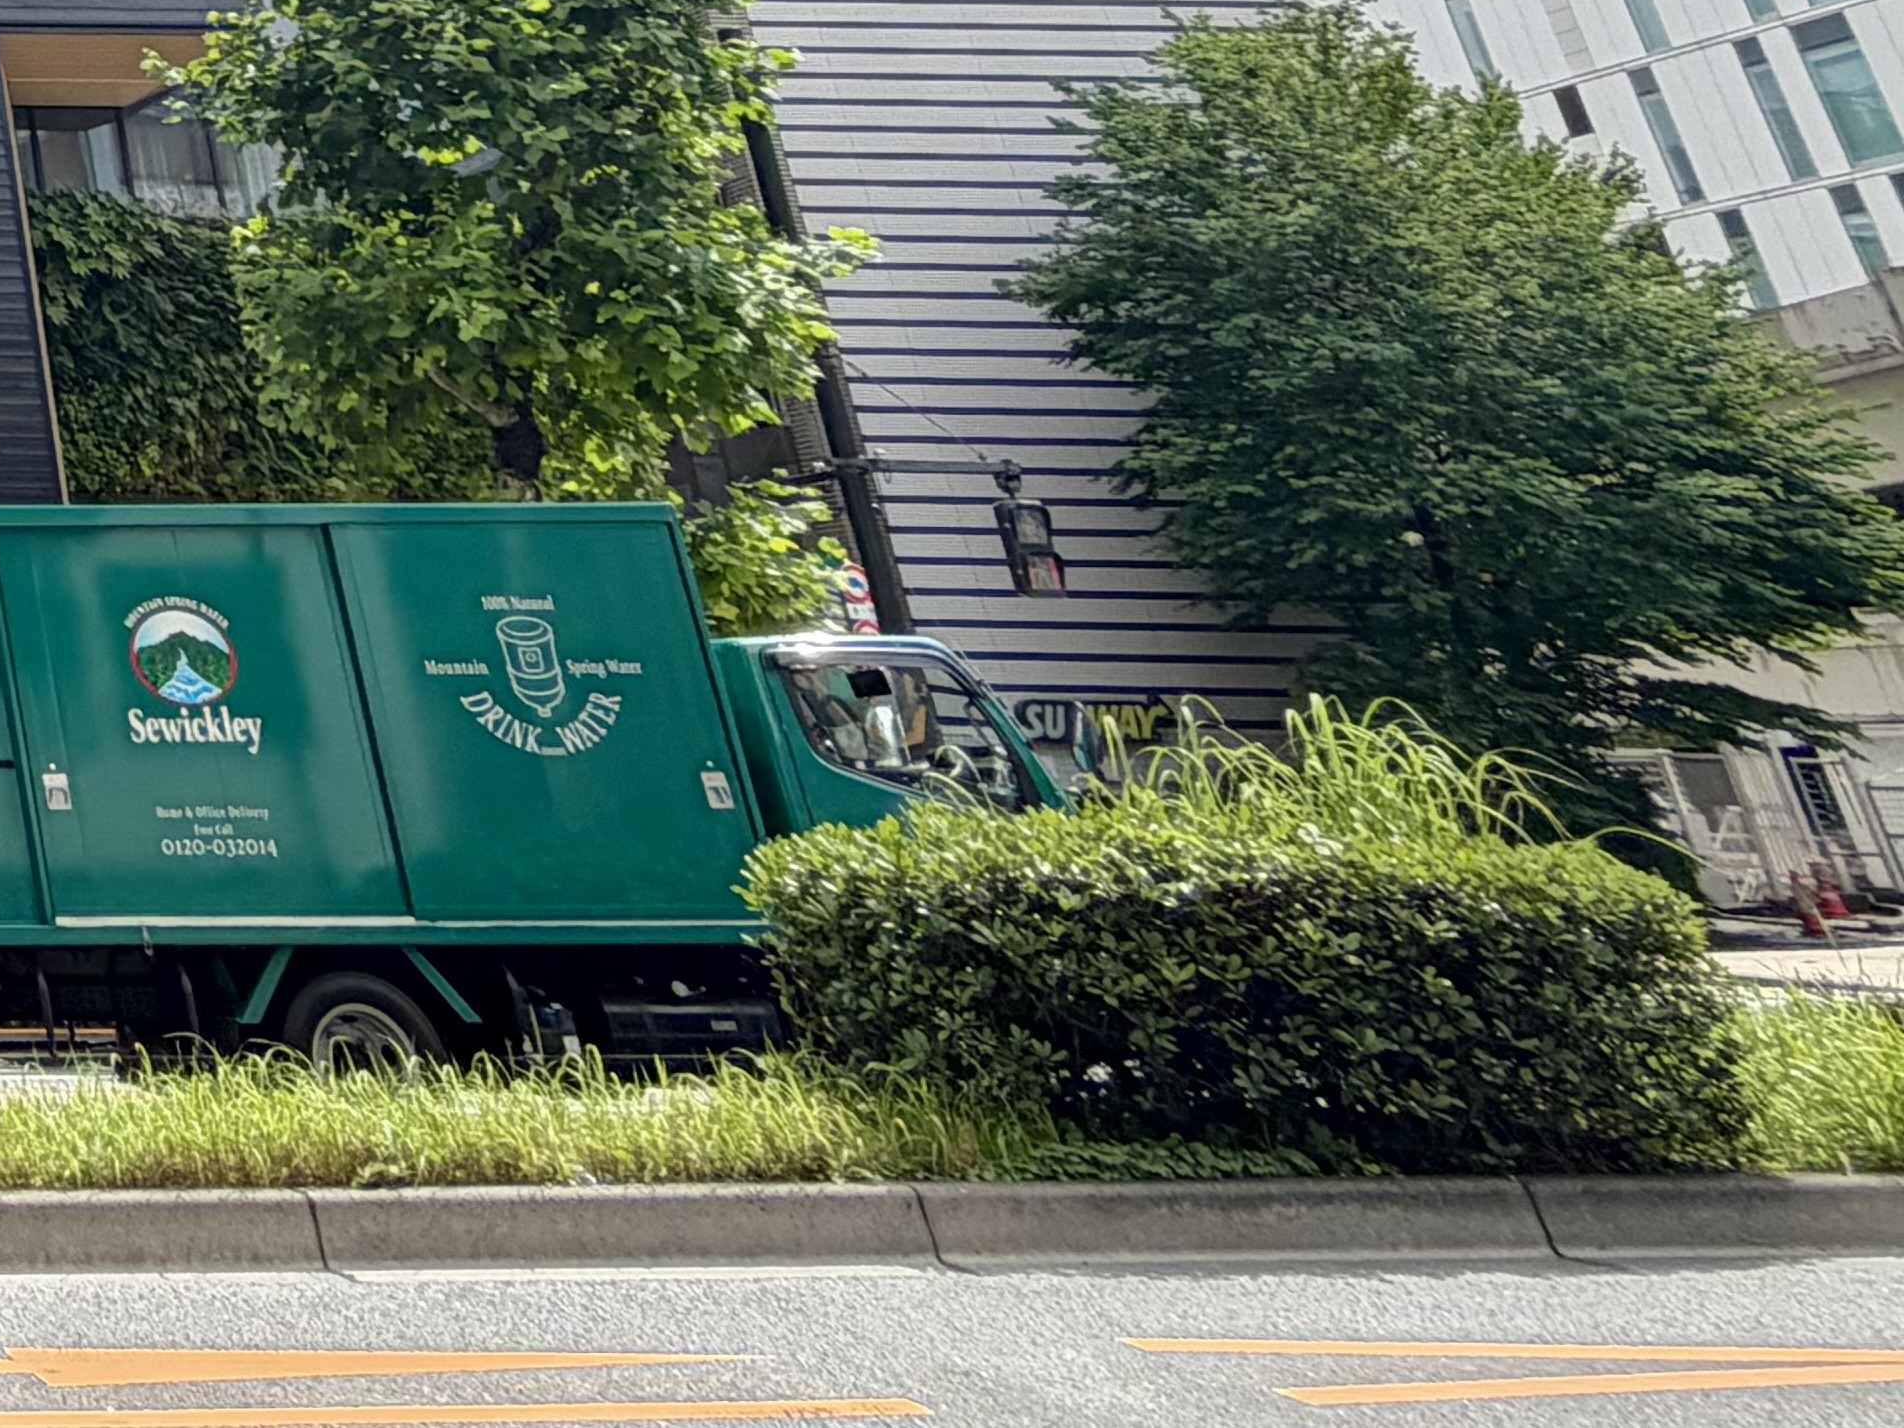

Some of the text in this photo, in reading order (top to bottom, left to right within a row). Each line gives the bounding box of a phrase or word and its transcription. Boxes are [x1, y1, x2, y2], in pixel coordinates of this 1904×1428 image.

[510, 594, 555, 611] Natural
[424, 659, 489, 676] Mountain
[566, 659, 642, 679] Spring Water
[128, 705, 262, 755] Sewickley
[460, 690, 622, 754] DRINK WATER
[1026, 703, 1168, 740] SUWAY
[161, 839, 278, 858] 0120-032014
